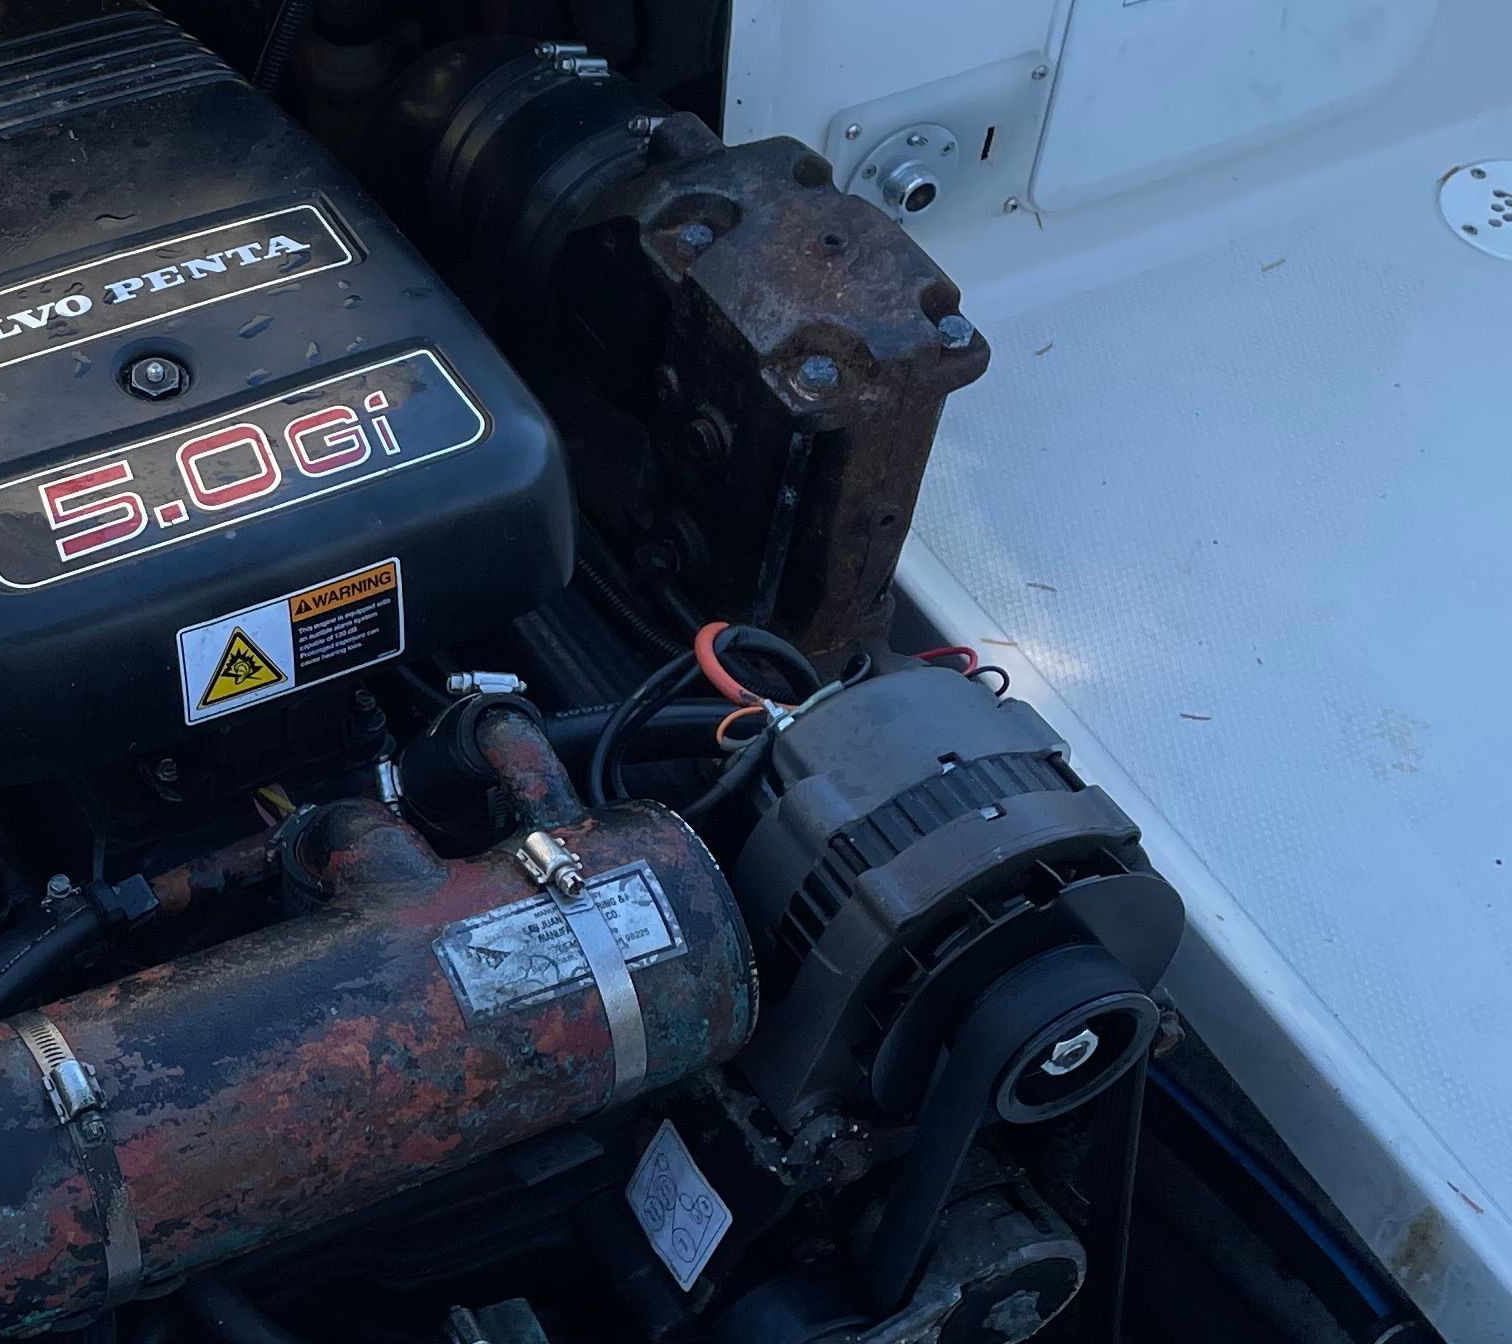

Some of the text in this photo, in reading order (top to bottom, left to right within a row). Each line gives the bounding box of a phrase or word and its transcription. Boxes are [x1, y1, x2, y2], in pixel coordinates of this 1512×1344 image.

[104, 233, 311, 305] PENTA
[38, 390, 402, 562] 5.0Gi
[312, 571, 392, 608] WARNING
[298, 623, 313, 634] This
[314, 618, 336, 629] engine
[344, 603, 376, 619] equipped
[309, 628, 333, 639] audible
[334, 620, 353, 631] alarm
[353, 612, 378, 624] system
[300, 639, 325, 652] capable
[300, 643, 335, 659] Prolonged
[335, 633, 366, 647] exposure
[300, 657, 320, 667] cause
[321, 648, 346, 660] hearing
